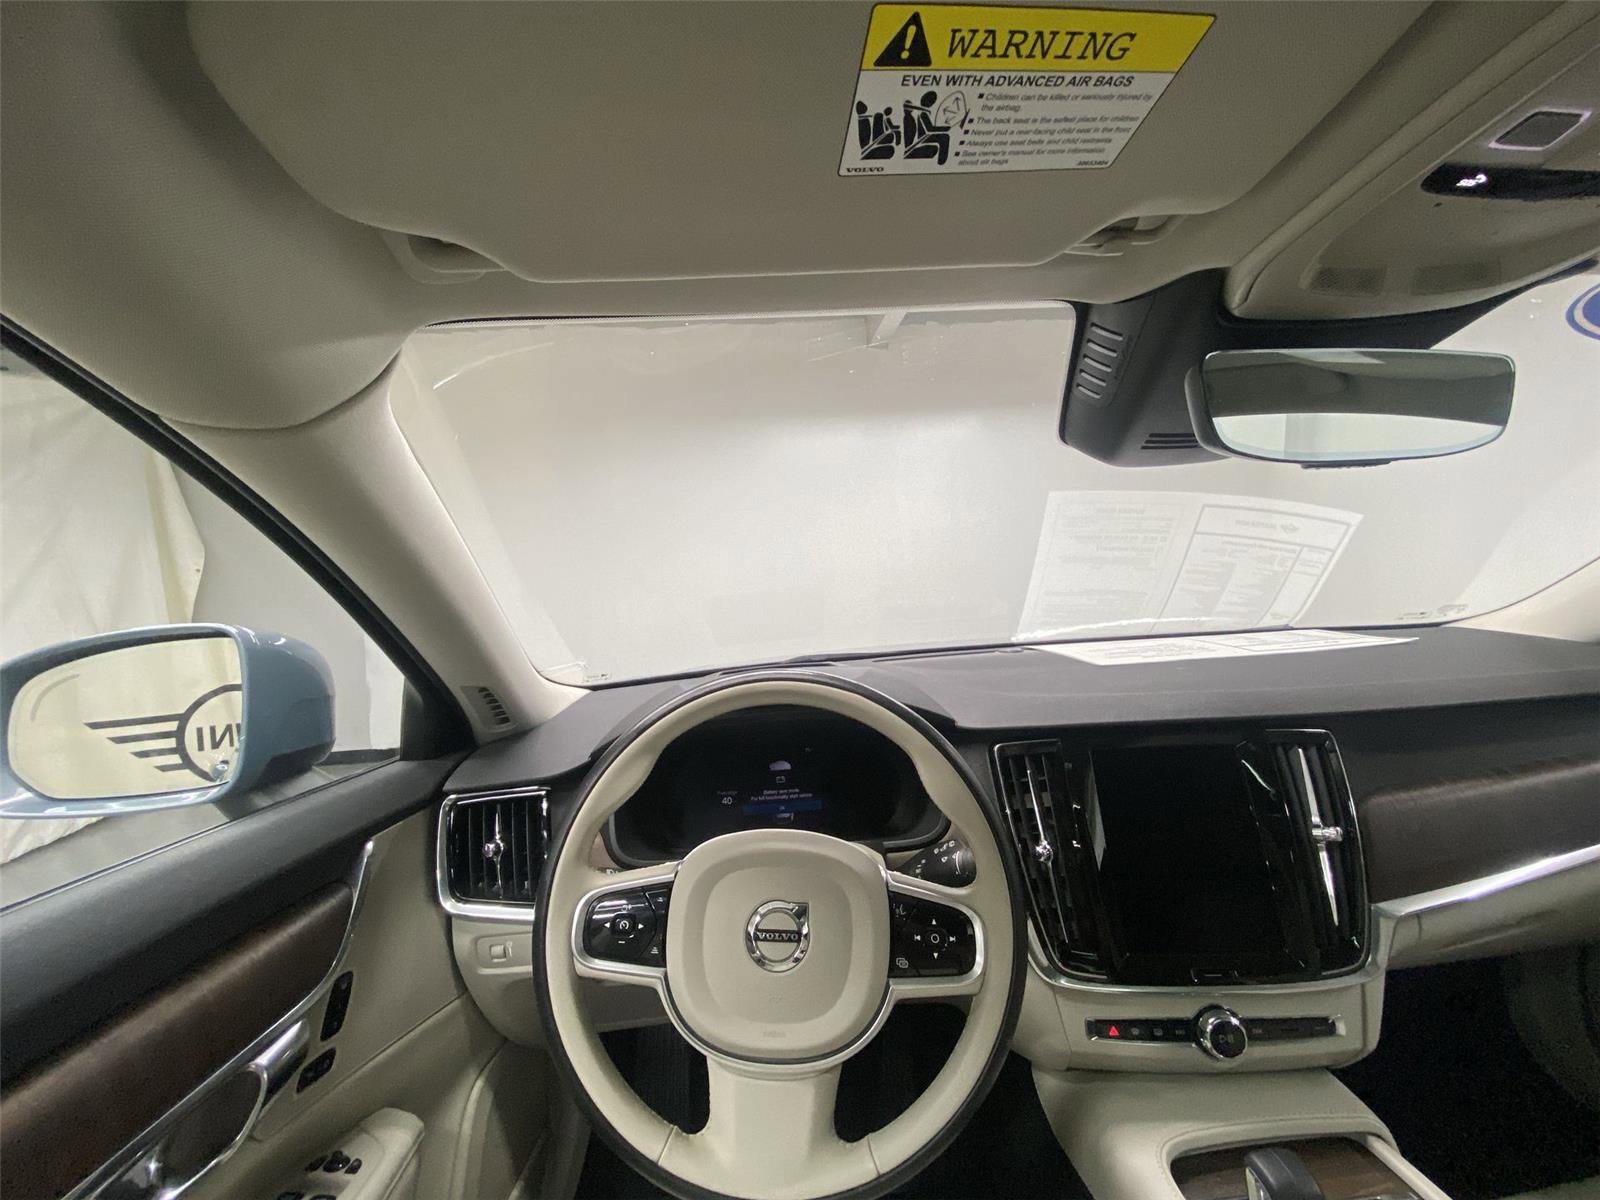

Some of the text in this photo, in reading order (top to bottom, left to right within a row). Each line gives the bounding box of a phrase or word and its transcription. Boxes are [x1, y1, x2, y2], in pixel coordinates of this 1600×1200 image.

[948, 28, 1137, 61] WARNING
[901, 75, 1134, 88] EVEN WITH ADVANCED AIR BAGS
[721, 796, 733, 805] 40
[756, 931, 799, 941] VOLVO
